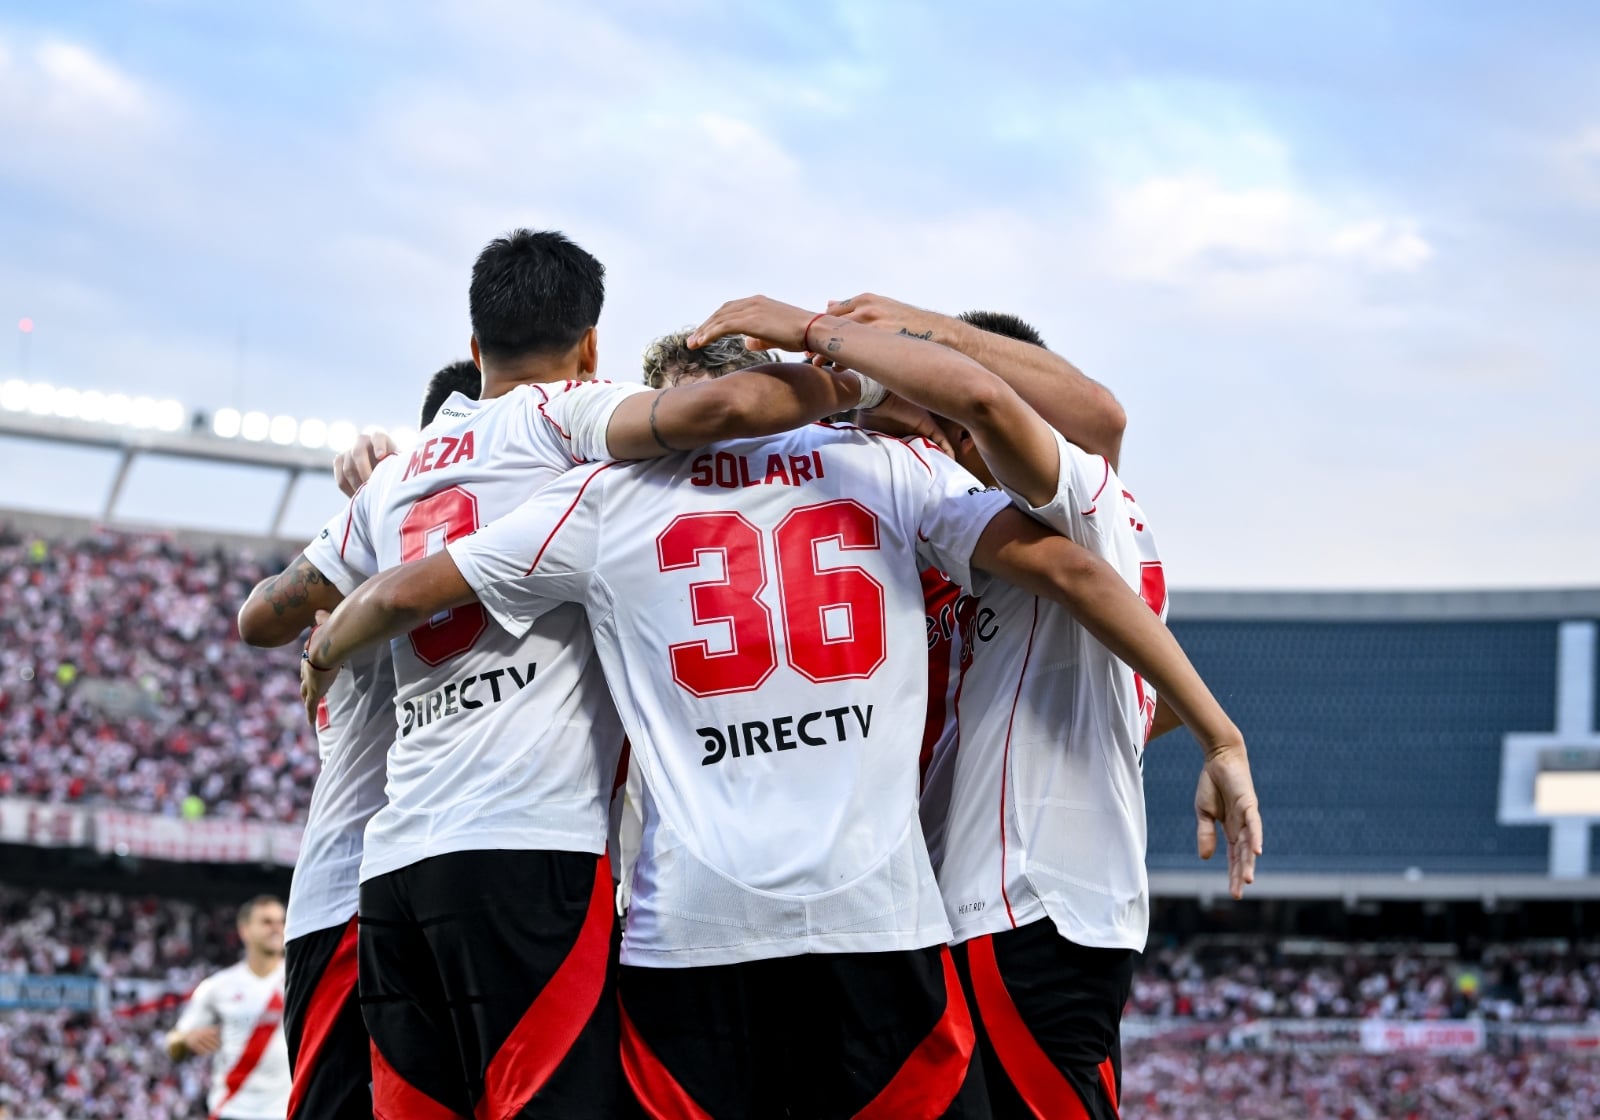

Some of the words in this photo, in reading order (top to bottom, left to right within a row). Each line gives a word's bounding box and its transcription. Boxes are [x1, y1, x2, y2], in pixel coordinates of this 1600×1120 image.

[401, 430, 475, 482] MEZA
[690, 450, 825, 489] SOLARI
[655, 498, 888, 699] 36
[402, 662, 537, 738] DIRECTV
[696, 704, 874, 766] DIRECTV
